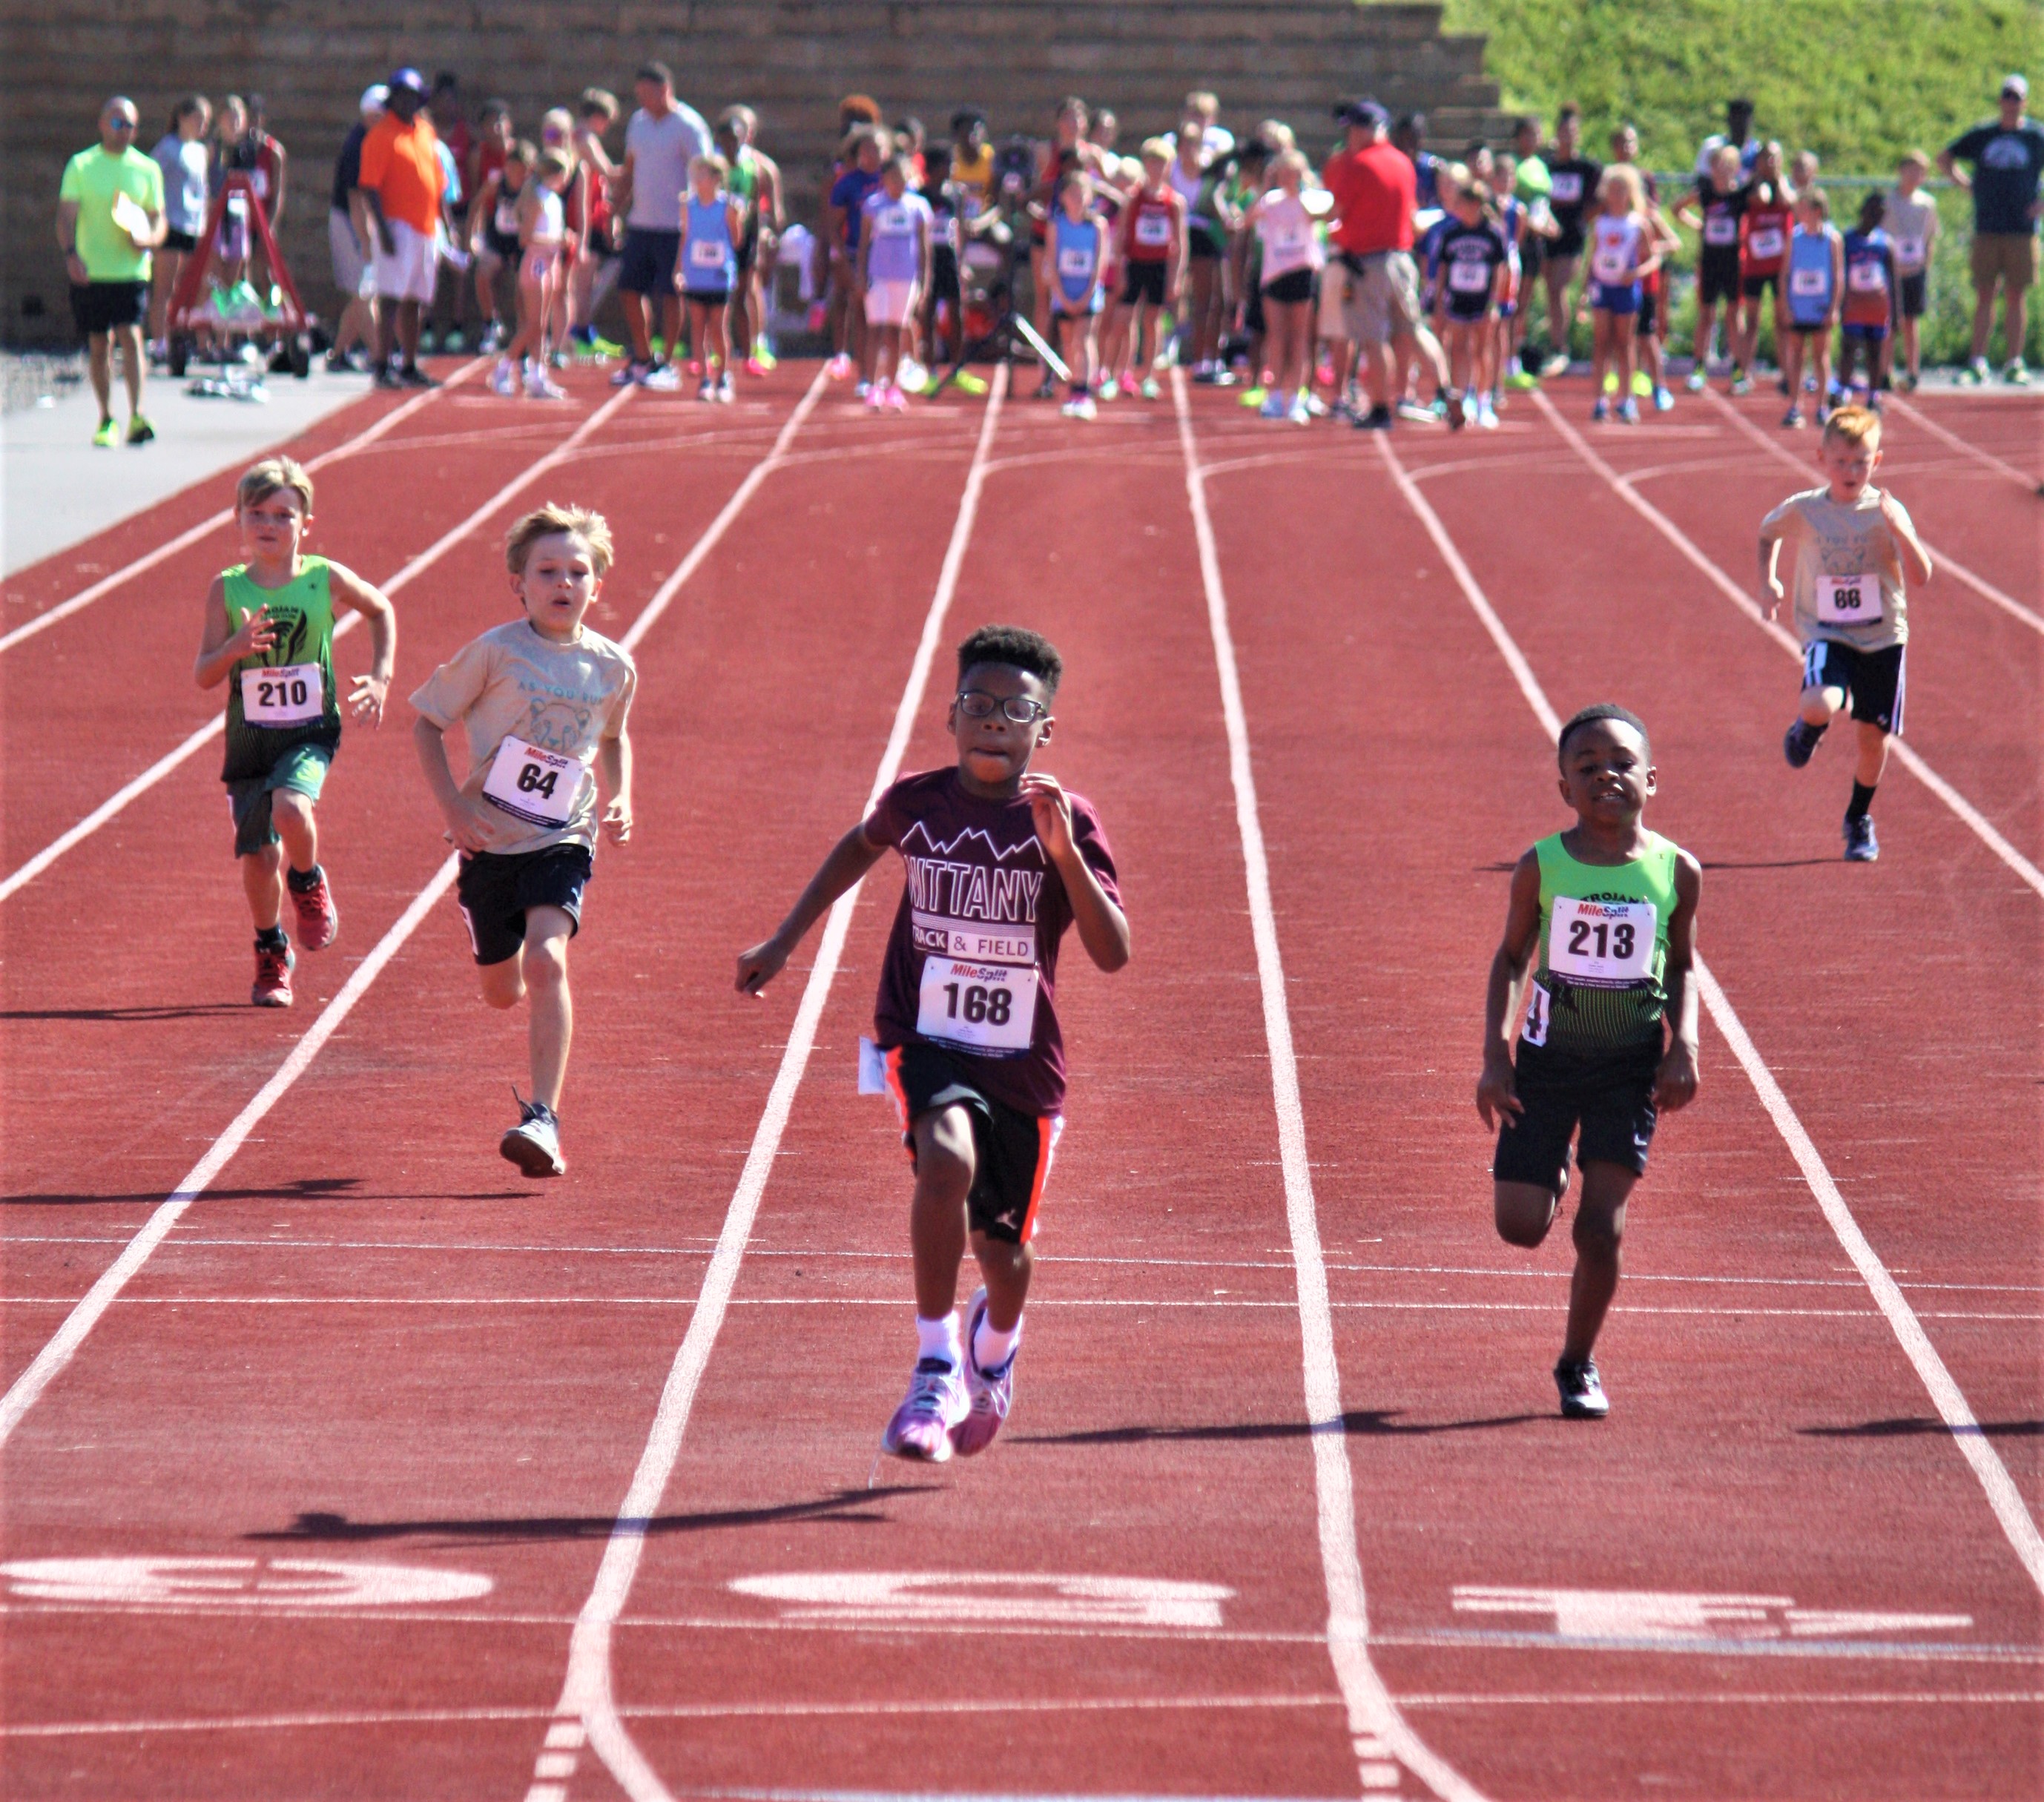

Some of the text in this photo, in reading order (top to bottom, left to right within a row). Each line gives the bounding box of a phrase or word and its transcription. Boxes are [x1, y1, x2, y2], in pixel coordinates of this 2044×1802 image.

[257, 680, 307, 707] 210
[517, 763, 558, 799] 64
[1577, 903, 1629, 920] MileSplit
[954, 936, 966, 951] &
[978, 939, 1029, 956] FIELD
[1568, 920, 1635, 960] 213
[950, 963, 1007, 982] MileSplit
[943, 983, 1012, 1026] 168
